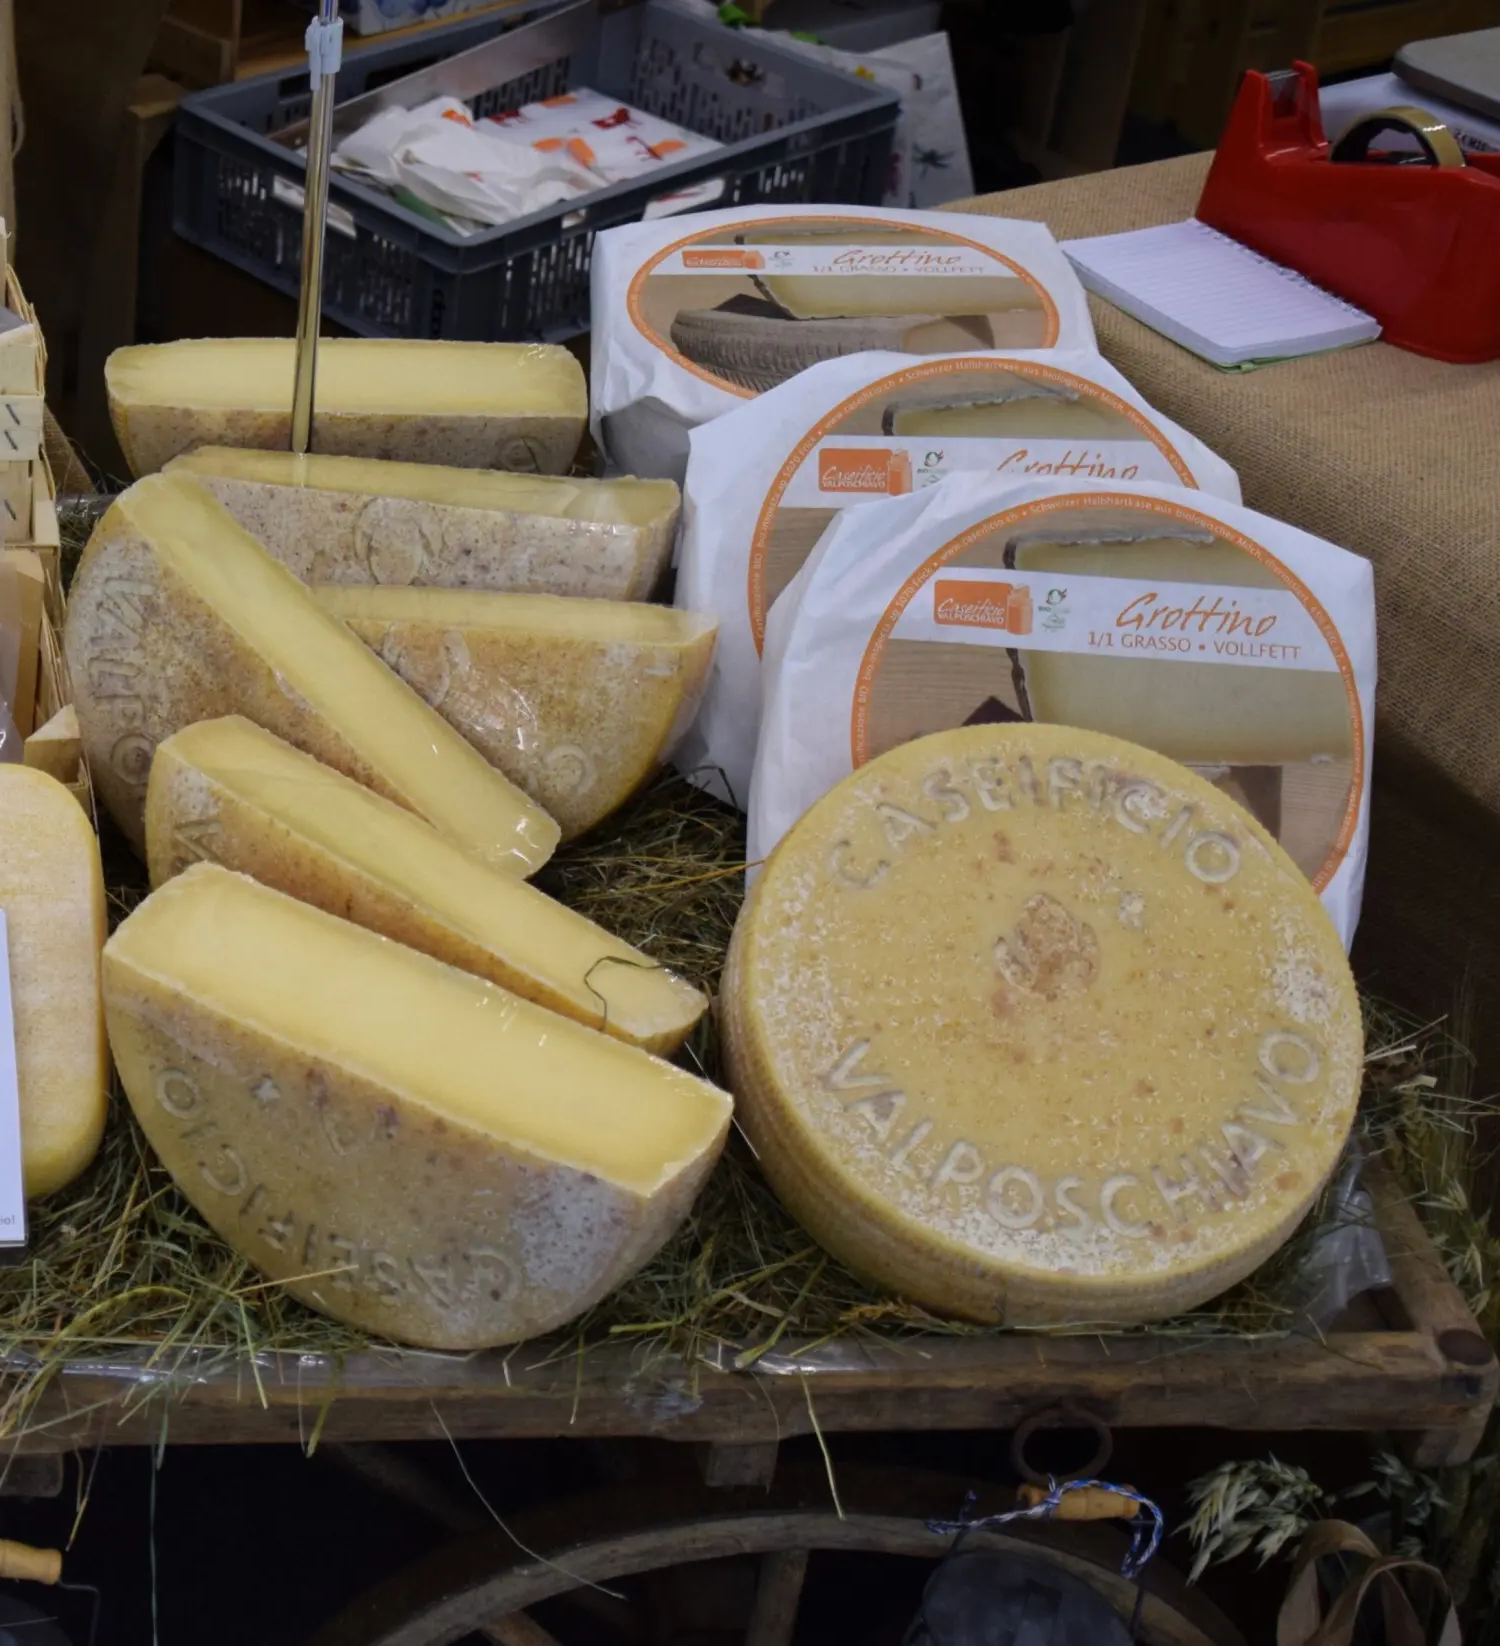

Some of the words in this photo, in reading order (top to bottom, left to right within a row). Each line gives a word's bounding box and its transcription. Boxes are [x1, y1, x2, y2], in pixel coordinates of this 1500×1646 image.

[833, 249, 962, 265] Grottino
[937, 598, 1005, 616] Caseificio
[1115, 591, 1278, 638] Grottino
[1088, 631, 1115, 648] 1/1
[1121, 633, 1191, 652] GRASSO
[1213, 640, 1301, 660] VOLLFETT
[824, 753, 1242, 891] CASEIFICIO
[819, 1029, 1321, 1239] VALPOSCHIAVO
